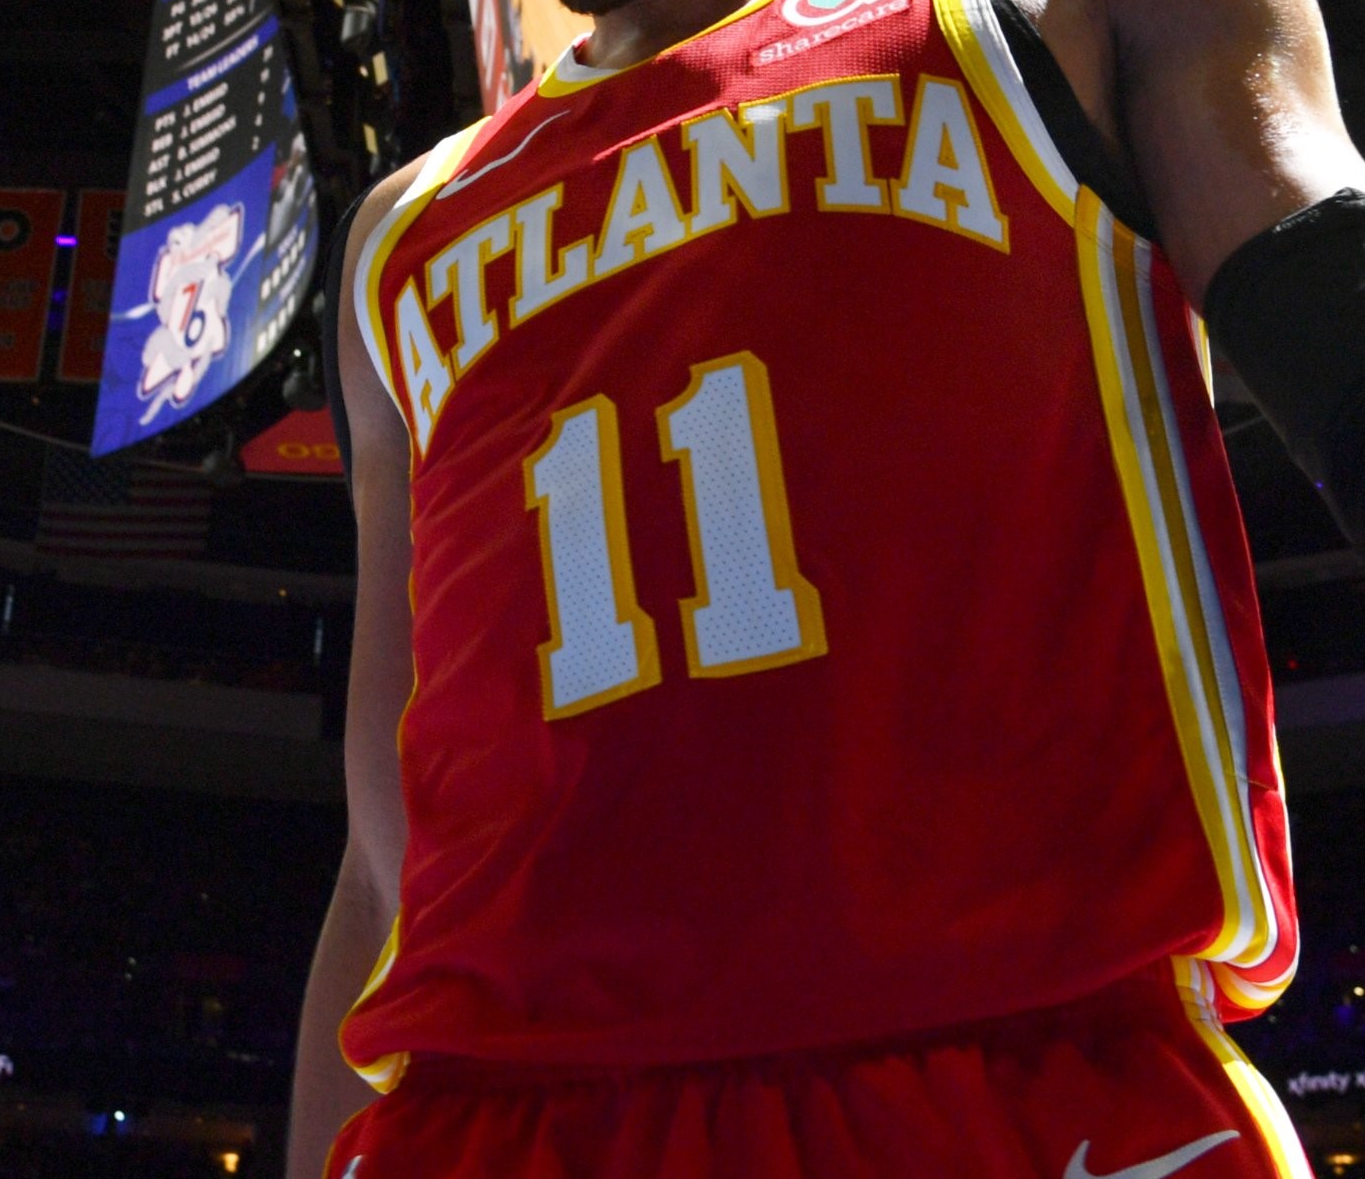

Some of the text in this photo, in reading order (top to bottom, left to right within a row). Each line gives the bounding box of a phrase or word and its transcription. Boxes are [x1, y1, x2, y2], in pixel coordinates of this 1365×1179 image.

[393, 73, 1013, 456] ATLANTA
[524, 350, 829, 721] 11
[1287, 1071, 1350, 1100] xfinity
